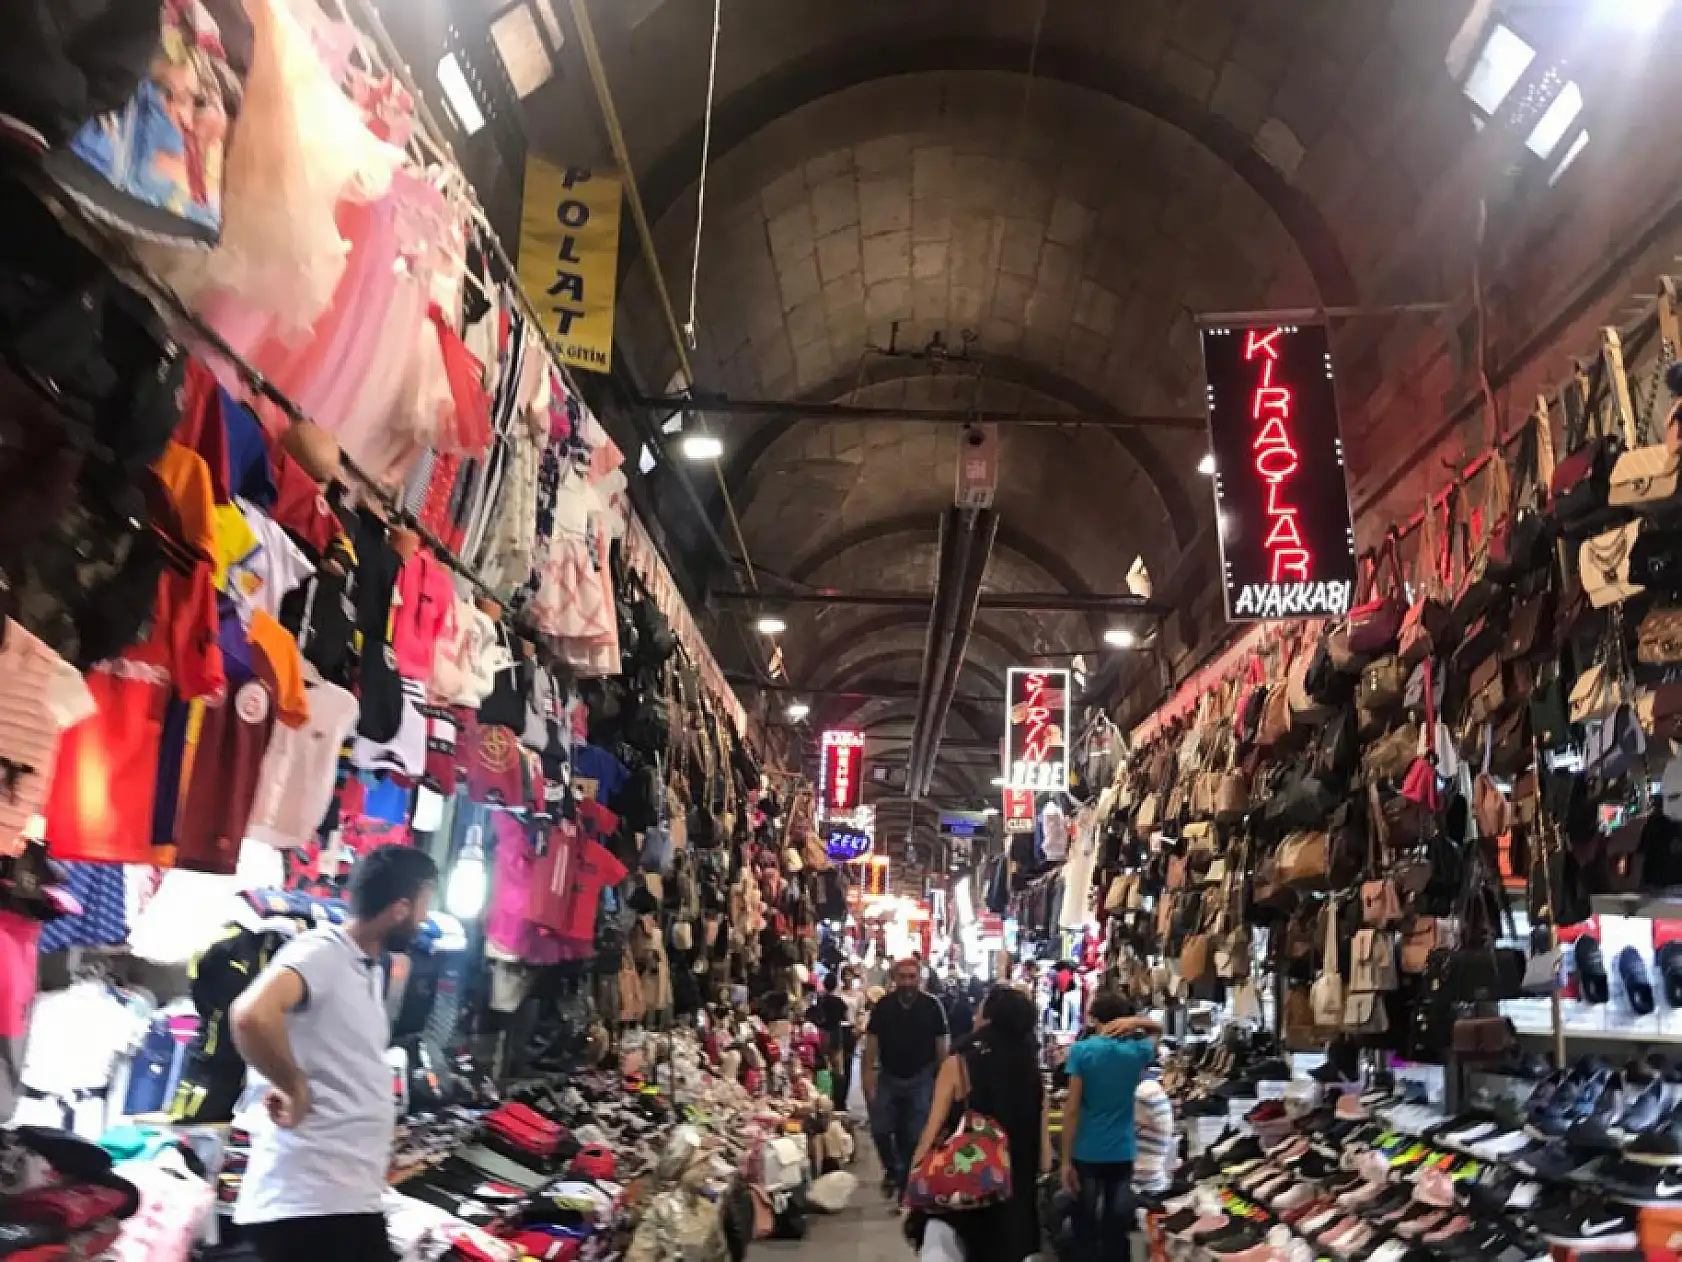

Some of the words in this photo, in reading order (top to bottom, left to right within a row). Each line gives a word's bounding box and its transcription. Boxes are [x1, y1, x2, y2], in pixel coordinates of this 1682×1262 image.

[546, 165, 592, 335] POLAT
[1244, 329, 1311, 582] KIRAÇLAR
[1235, 581, 1352, 616] AYAKKABI
